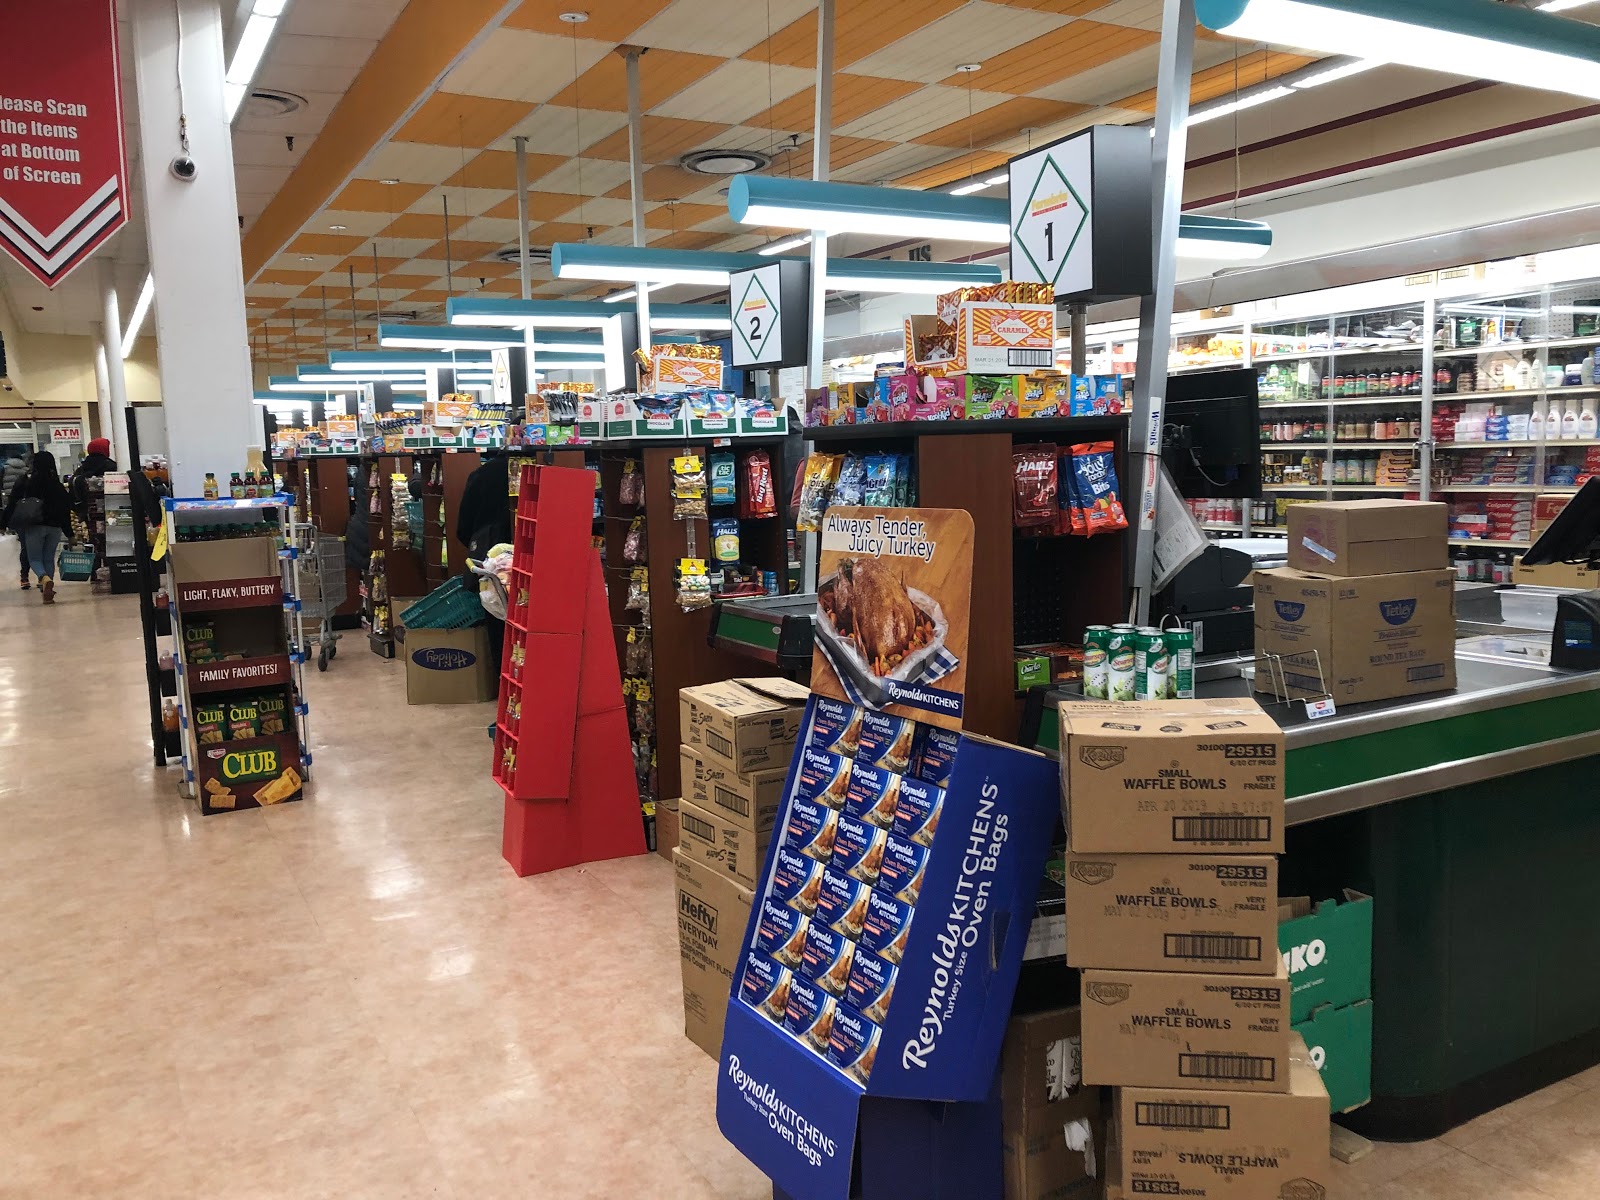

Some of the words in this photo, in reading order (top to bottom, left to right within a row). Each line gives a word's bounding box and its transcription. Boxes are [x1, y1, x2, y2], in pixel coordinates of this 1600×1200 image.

[0, 95, 43, 114] lease
[46, 99, 88, 118] Scan
[0, 119, 28, 135] the
[31, 121, 78, 139] Items
[1, 144, 18, 158] at
[21, 143, 80, 162] Bottom
[3, 166, 20, 180] of
[23, 167, 81, 185] Screen
[1044, 221, 1054, 261] 1
[750, 316, 762, 340] 2
[998, 326, 1029, 334] CARAMEL
[927, 409, 950, 421] Kool-Aid
[54, 429, 80, 437] ATM
[760, 467, 769, 487] Red
[756, 486, 765, 503] Big
[1092, 481, 1111, 494] Bits
[1486, 502, 1512, 510] Colgate
[717, 527, 738, 536] HALLS
[827, 514, 871, 538] Always
[875, 516, 927, 539] Tender,
[848, 534, 884, 558] Juicy
[888, 536, 935, 562] Turkey
[184, 589, 210, 601] LIGHT,
[212, 587, 239, 599] FLAKY,
[241, 584, 275, 597] BUTTERY
[1279, 603, 1301, 618] Tetley
[1385, 602, 1412, 619] Tetley
[187, 628, 214, 642] CLUB
[426, 651, 468, 668] Holiday
[199, 667, 230, 682] FAMILY
[232, 663, 278, 680] FAVORITES!
[259, 699, 284, 714] CLUB
[818, 700, 843, 714] Reynolds
[197, 711, 224, 725] CLUB
[230, 708, 257, 721] CLUB
[826, 712, 846, 722] KITCHENS
[863, 712, 890, 727] Reynolds
[872, 725, 894, 736] KITCHENS
[929, 728, 957, 745] Reynolds
[805, 749, 831, 765] Reynolds
[1196, 743, 1225, 752] 30100
[1225, 744, 1276, 758] 29515
[222, 750, 277, 779] CLUB
[813, 762, 834, 774] KITCHENS
[853, 764, 878, 781] Reynolds
[1158, 769, 1192, 778] SMALL
[1255, 775, 1276, 783] VERY
[861, 778, 882, 790] KITCHENS
[900, 781, 927, 799] Reynolds
[1124, 778, 1176, 790] WAFFLE
[1179, 778, 1227, 790] BOWLS
[1243, 782, 1276, 790] FRAGILE
[793, 799, 817, 816] Reynolds
[909, 795, 931, 808] KITCHENS
[801, 813, 821, 825] KITCHENS
[839, 817, 864, 835] Reynolds
[847, 832, 867, 845] KITCHENS
[980, 814, 1009, 872] Bags
[887, 837, 914, 856] Reynolds
[950, 783, 999, 921] KITCHENS
[780, 849, 803, 868] Reynolds
[896, 853, 917, 867] KITCHENS
[787, 864, 807, 877] KITCHENS
[1188, 864, 1216, 872] 30100
[1218, 866, 1265, 879] 29515
[824, 870, 848, 890] Reynolds
[832, 886, 851, 900] KITCHENS
[1149, 887, 1183, 896] SMALL
[870, 893, 898, 915] Reynolds
[1115, 895, 1167, 907] WAFFLE
[1171, 896, 1218, 909] BOWLS
[1233, 903, 1266, 912] FRAGILE
[1245, 896, 1265, 904] VERY
[681, 894, 715, 931] Hefty
[765, 901, 790, 920] Reynolds
[879, 910, 901, 924] KITCHENS
[961, 881, 992, 948] Oven
[772, 916, 792, 930] KITCHENS
[678, 918, 719, 951] EVERYDAY
[808, 924, 833, 945] Reynolds
[816, 940, 836, 955] KITCHENS
[749, 952, 771, 973] Reynolds
[855, 950, 881, 973] Reynolds
[955, 951, 968, 977] Size
[755, 969, 774, 982] KITCHENS
[863, 968, 885, 984] KITCHENS
[791, 978, 815, 1001] Reynolds
[1231, 987, 1280, 1001] 29515
[798, 995, 818, 1011] KITCHENS
[943, 978, 962, 1022] Turkey
[834, 1007, 861, 1032] Reynolds
[1164, 1007, 1198, 1018] SMALL
[1131, 1015, 1182, 1028] WAFFLE
[1186, 1017, 1232, 1031] BOWLS
[1248, 1024, 1280, 1033] FRAGILE
[843, 1025, 865, 1043] KITCHENS
[743, 1091, 758, 1111] Turkey
[758, 1104, 768, 1118] Size
[768, 1112, 795, 1145] Oven
[797, 1133, 822, 1167] Bags
[779, 1101, 835, 1158] KITCHENS
[1178, 1152, 1225, 1165] BOWLS
[1230, 1154, 1279, 1168] WAFFLE
[1213, 1164, 1245, 1175] SMALL
[1132, 1181, 1180, 1193] 29515
